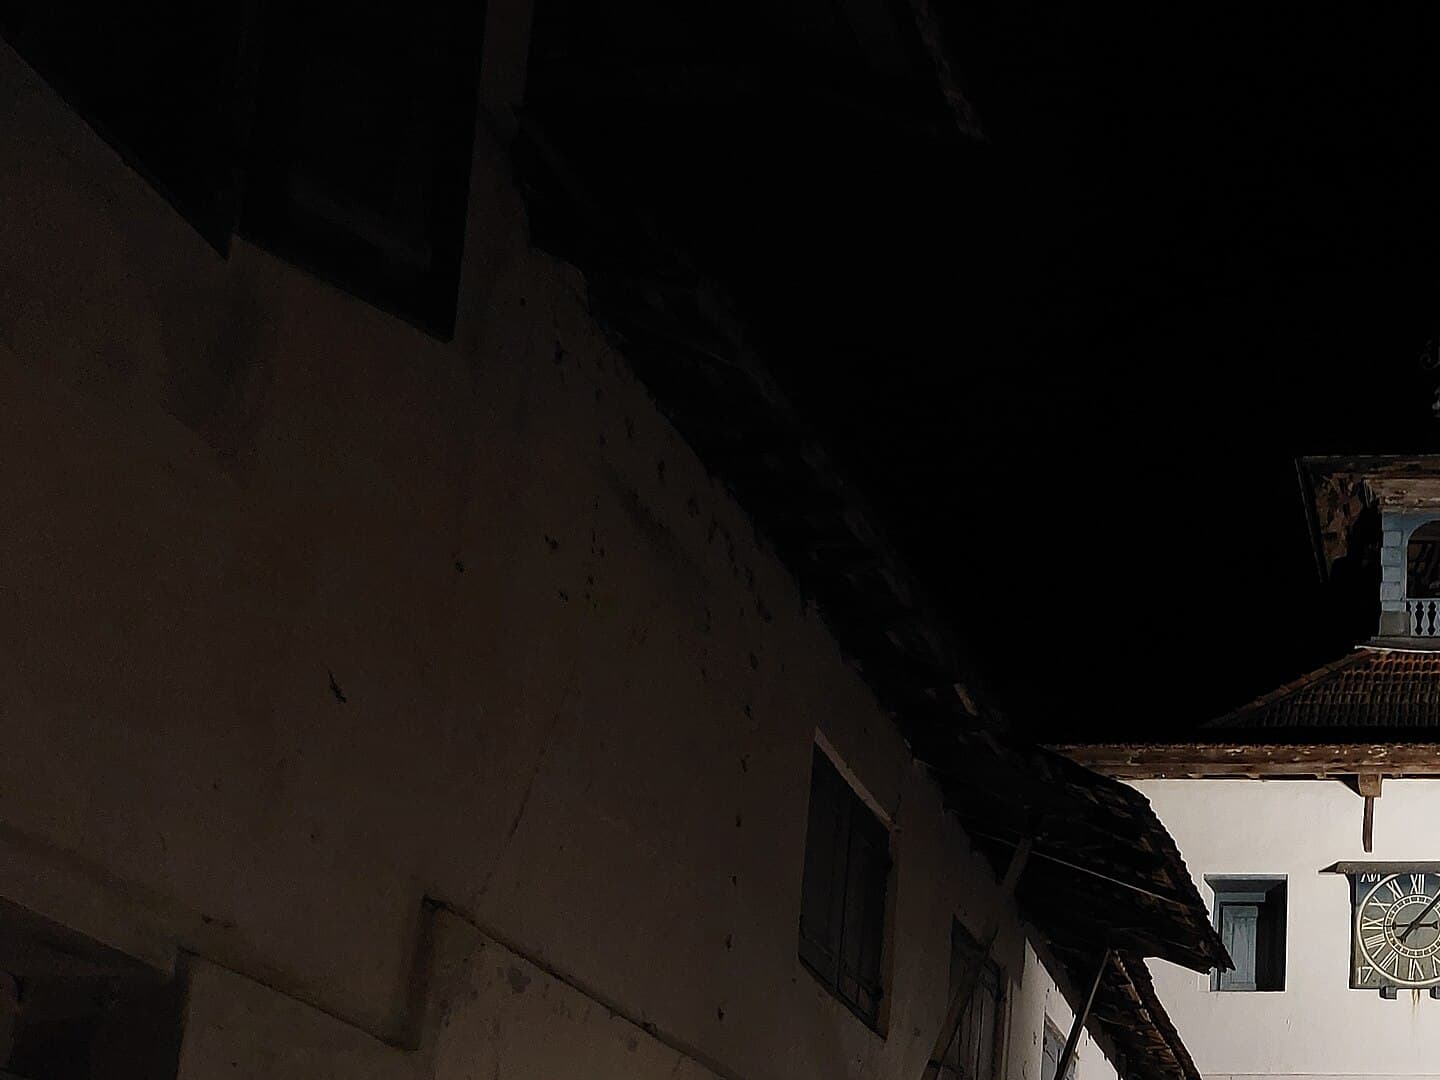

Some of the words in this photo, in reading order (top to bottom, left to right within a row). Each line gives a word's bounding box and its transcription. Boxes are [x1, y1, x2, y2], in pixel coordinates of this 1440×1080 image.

[1386, 878, 1404, 901] XI
[1410, 873, 1425, 894] XII
[1368, 896, 1392, 913] X
[1362, 916, 1385, 930] IX
[1357, 966, 1376, 985] 17
[1408, 958, 1425, 980] VI
